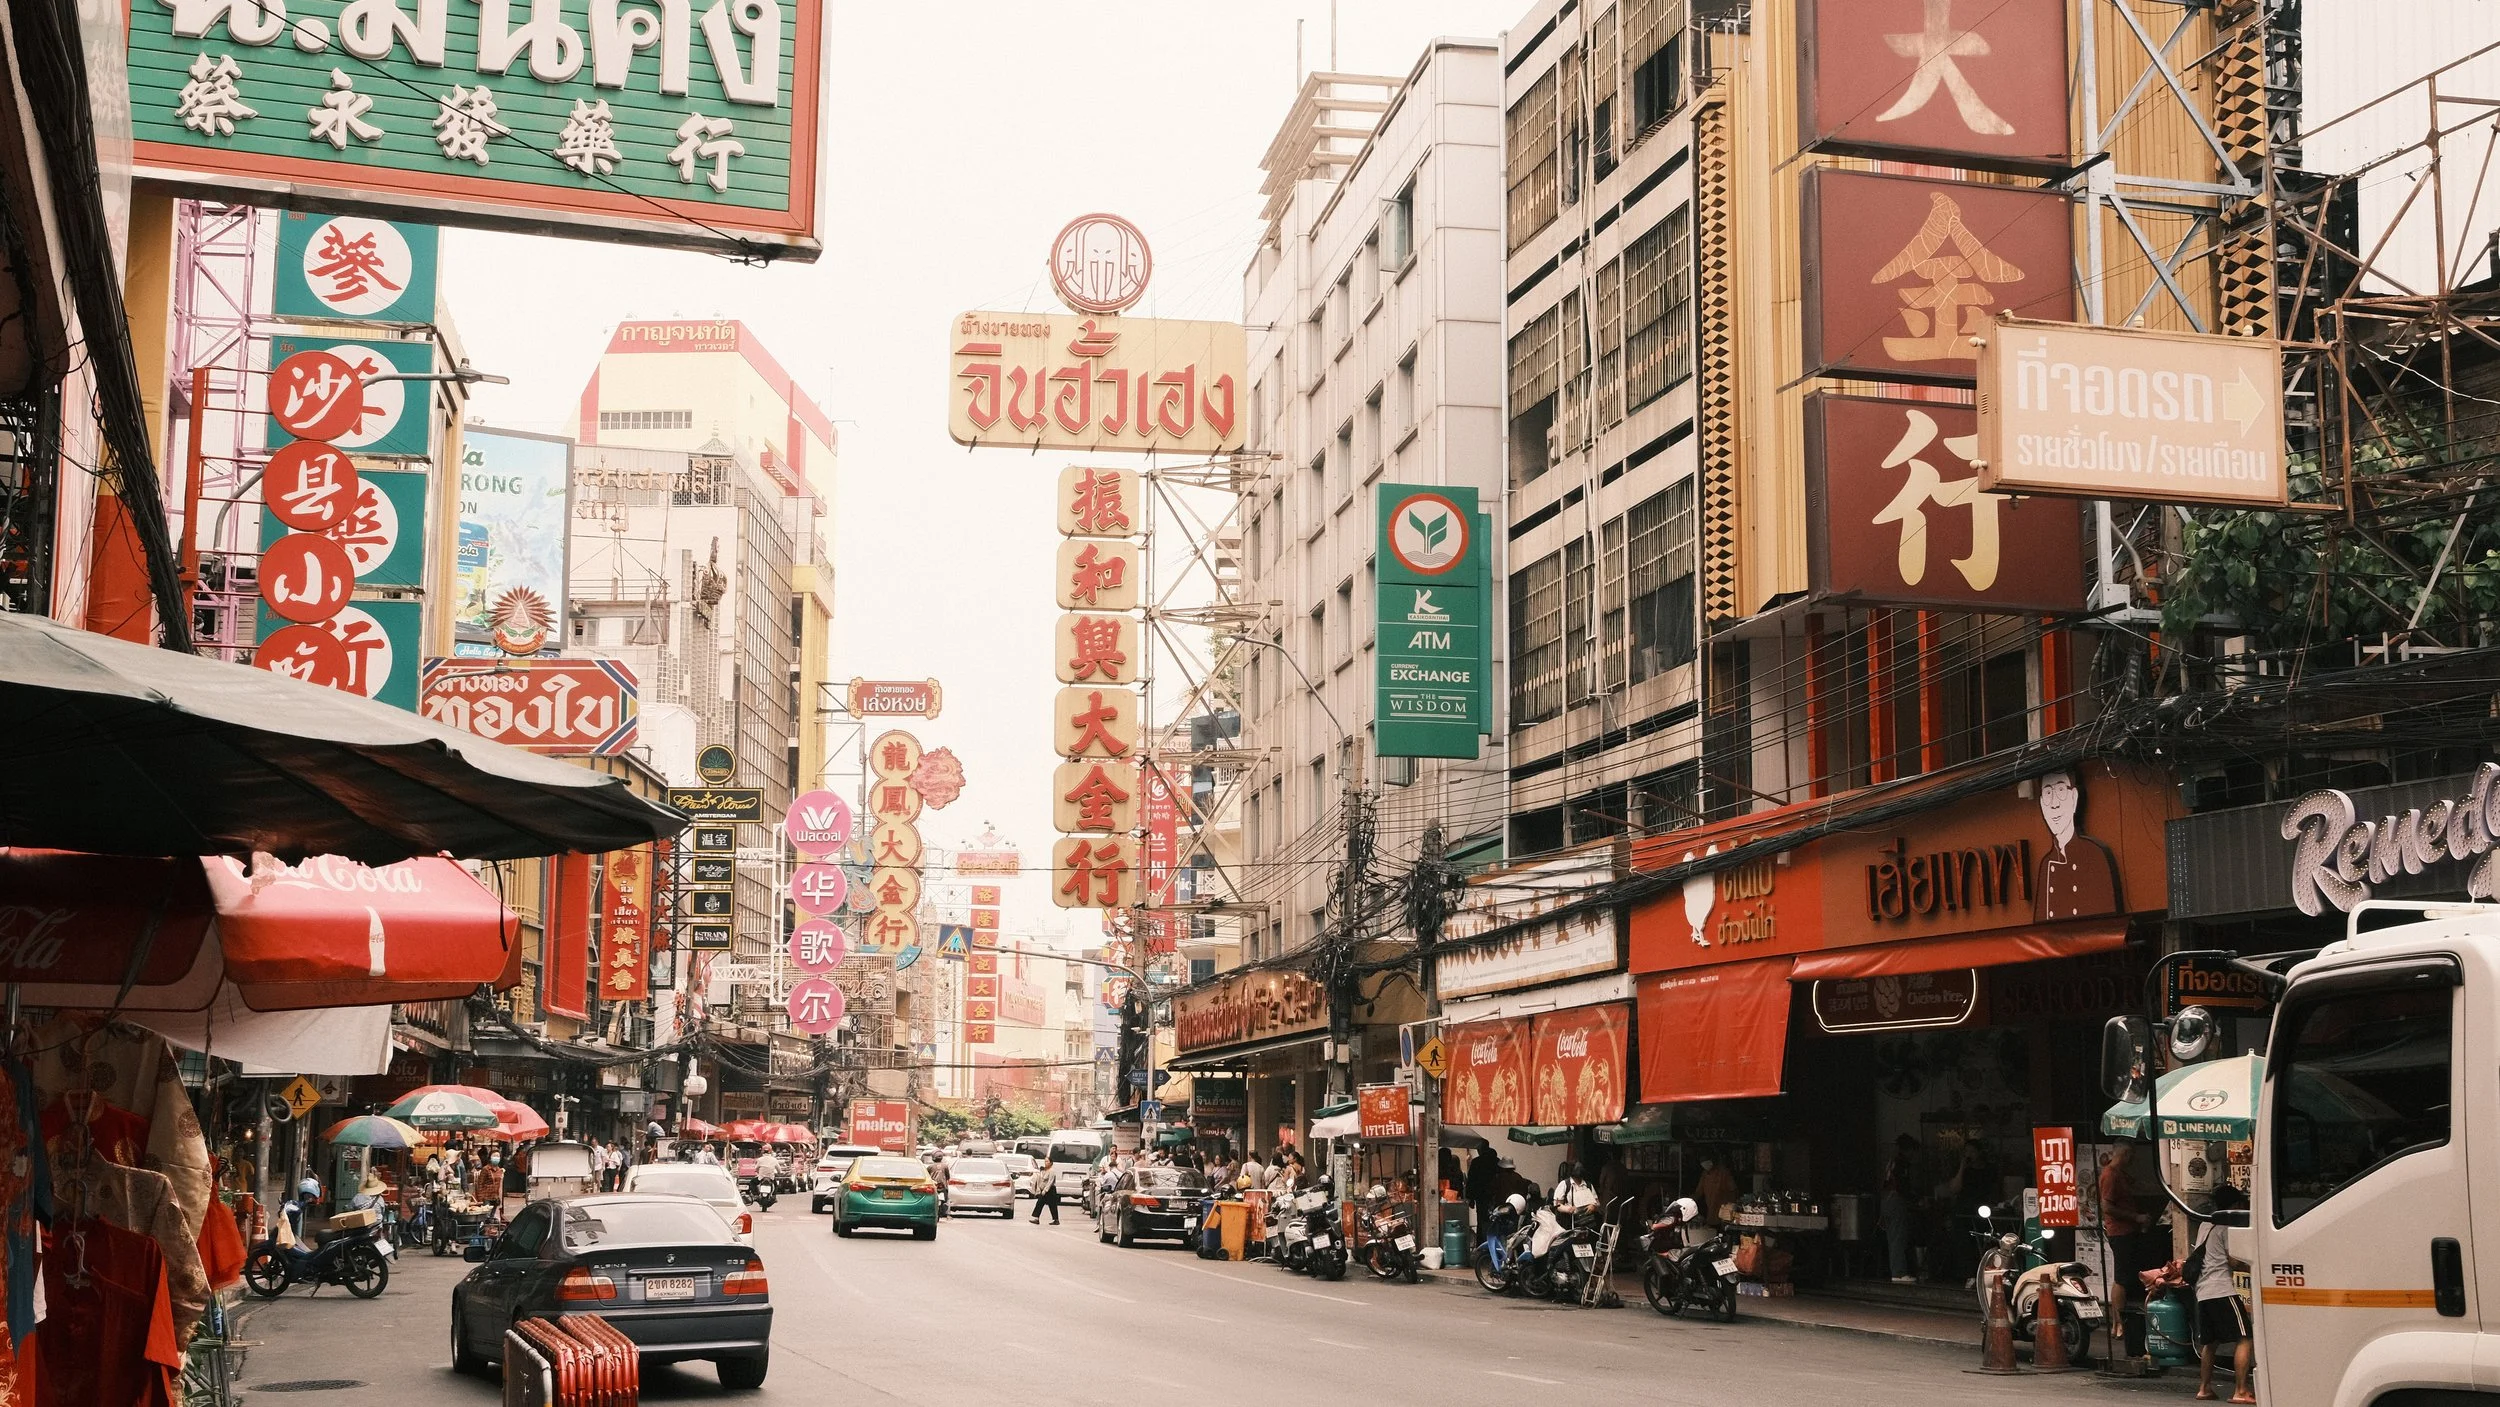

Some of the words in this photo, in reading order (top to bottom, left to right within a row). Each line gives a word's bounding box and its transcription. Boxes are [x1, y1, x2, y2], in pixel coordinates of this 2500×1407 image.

[174, 52, 745, 193] 蔡永發藥行
[1871, 0, 2026, 592] 大金行
[960, 314, 1051, 339] ห้างขายทอง
[2017, 336, 2214, 424] ที่จอดรถ
[2018, 424, 2267, 482] รายชั่วโมง/รายเดือน
[1408, 631, 1450, 650] ATM
[1061, 469, 1130, 907] 振和興大金行
[1390, 669, 1470, 683] EXCHANGE
[424, 673, 615, 739] ทองใบ
[1390, 700, 1467, 713] WISDOM
[702, 833, 728, 846] 温室
[796, 831, 841, 842] Wacoal
[874, 741, 911, 947] 龍鳳大金行
[1717, 900, 1776, 945] ข้าวมันไก่
[607, 926, 640, 991] 林真香
[799, 871, 835, 1024] 华歌尔
[856, 1118, 905, 1132] makro
[1365, 1120, 1406, 1136] เกาลัด
[2271, 1264, 2305, 1275] FRR
[2275, 1276, 2305, 1287] 210
[670, 1278, 693, 1289] 8282
